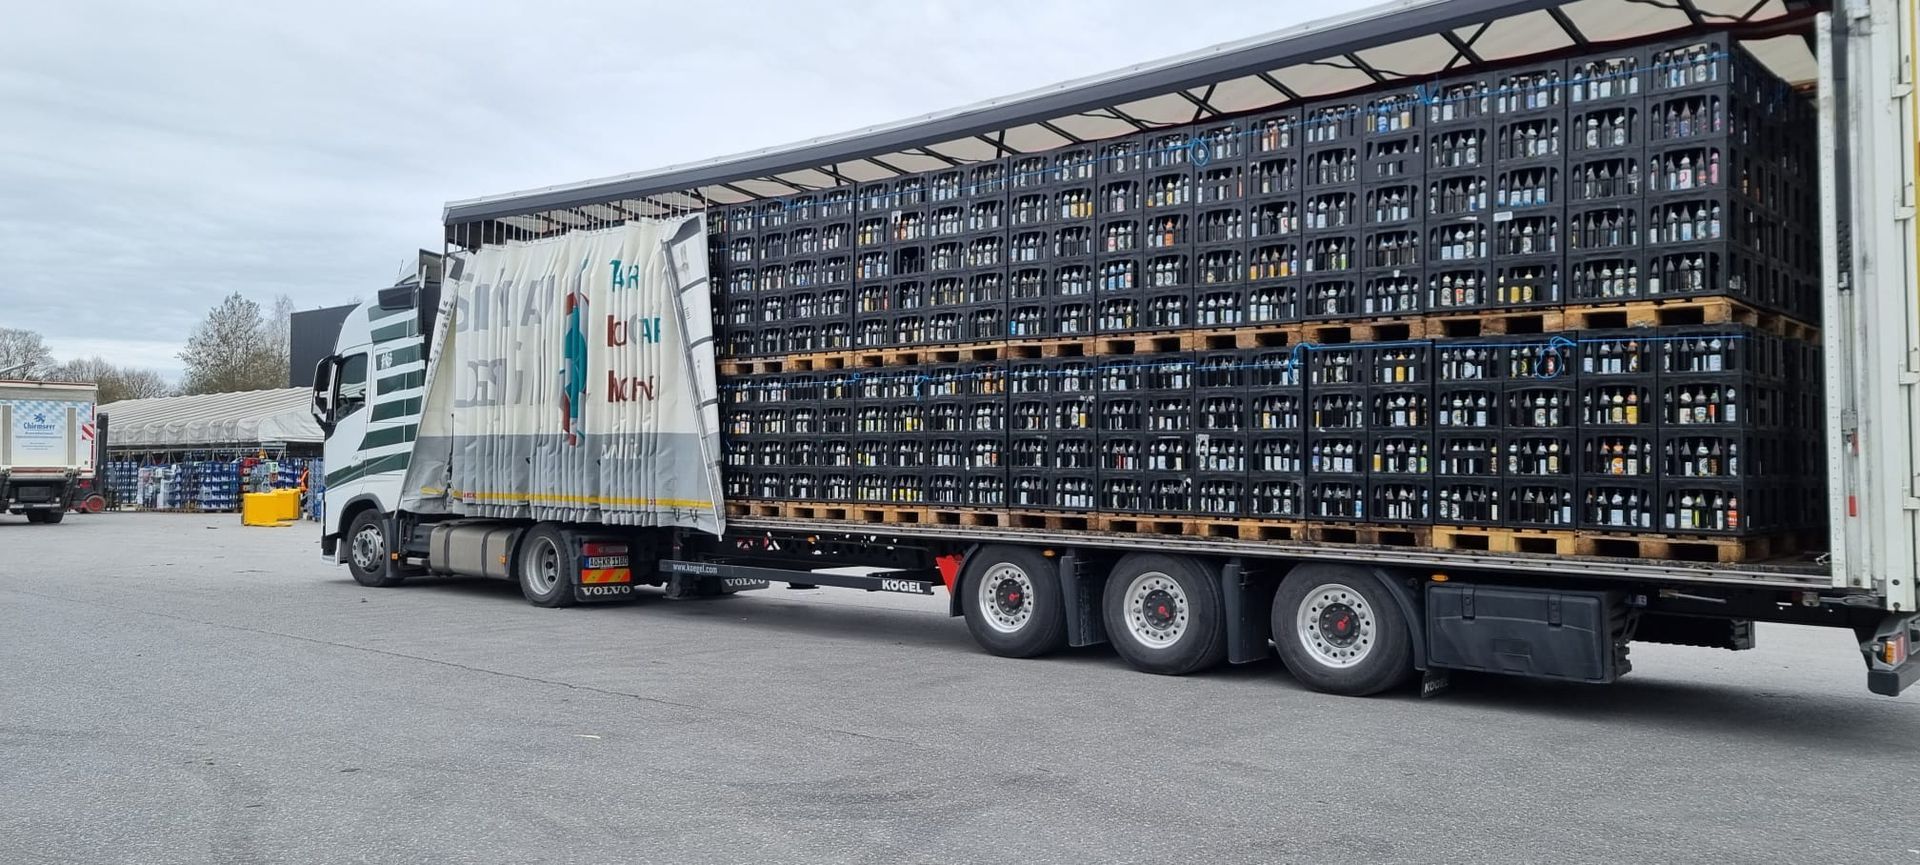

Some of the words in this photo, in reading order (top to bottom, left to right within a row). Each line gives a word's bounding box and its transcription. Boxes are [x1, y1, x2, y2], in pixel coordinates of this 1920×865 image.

[672, 563, 718, 574] www.koegel.com
[581, 585, 631, 596] VOLVO
[882, 579, 924, 593] KÖGEL
